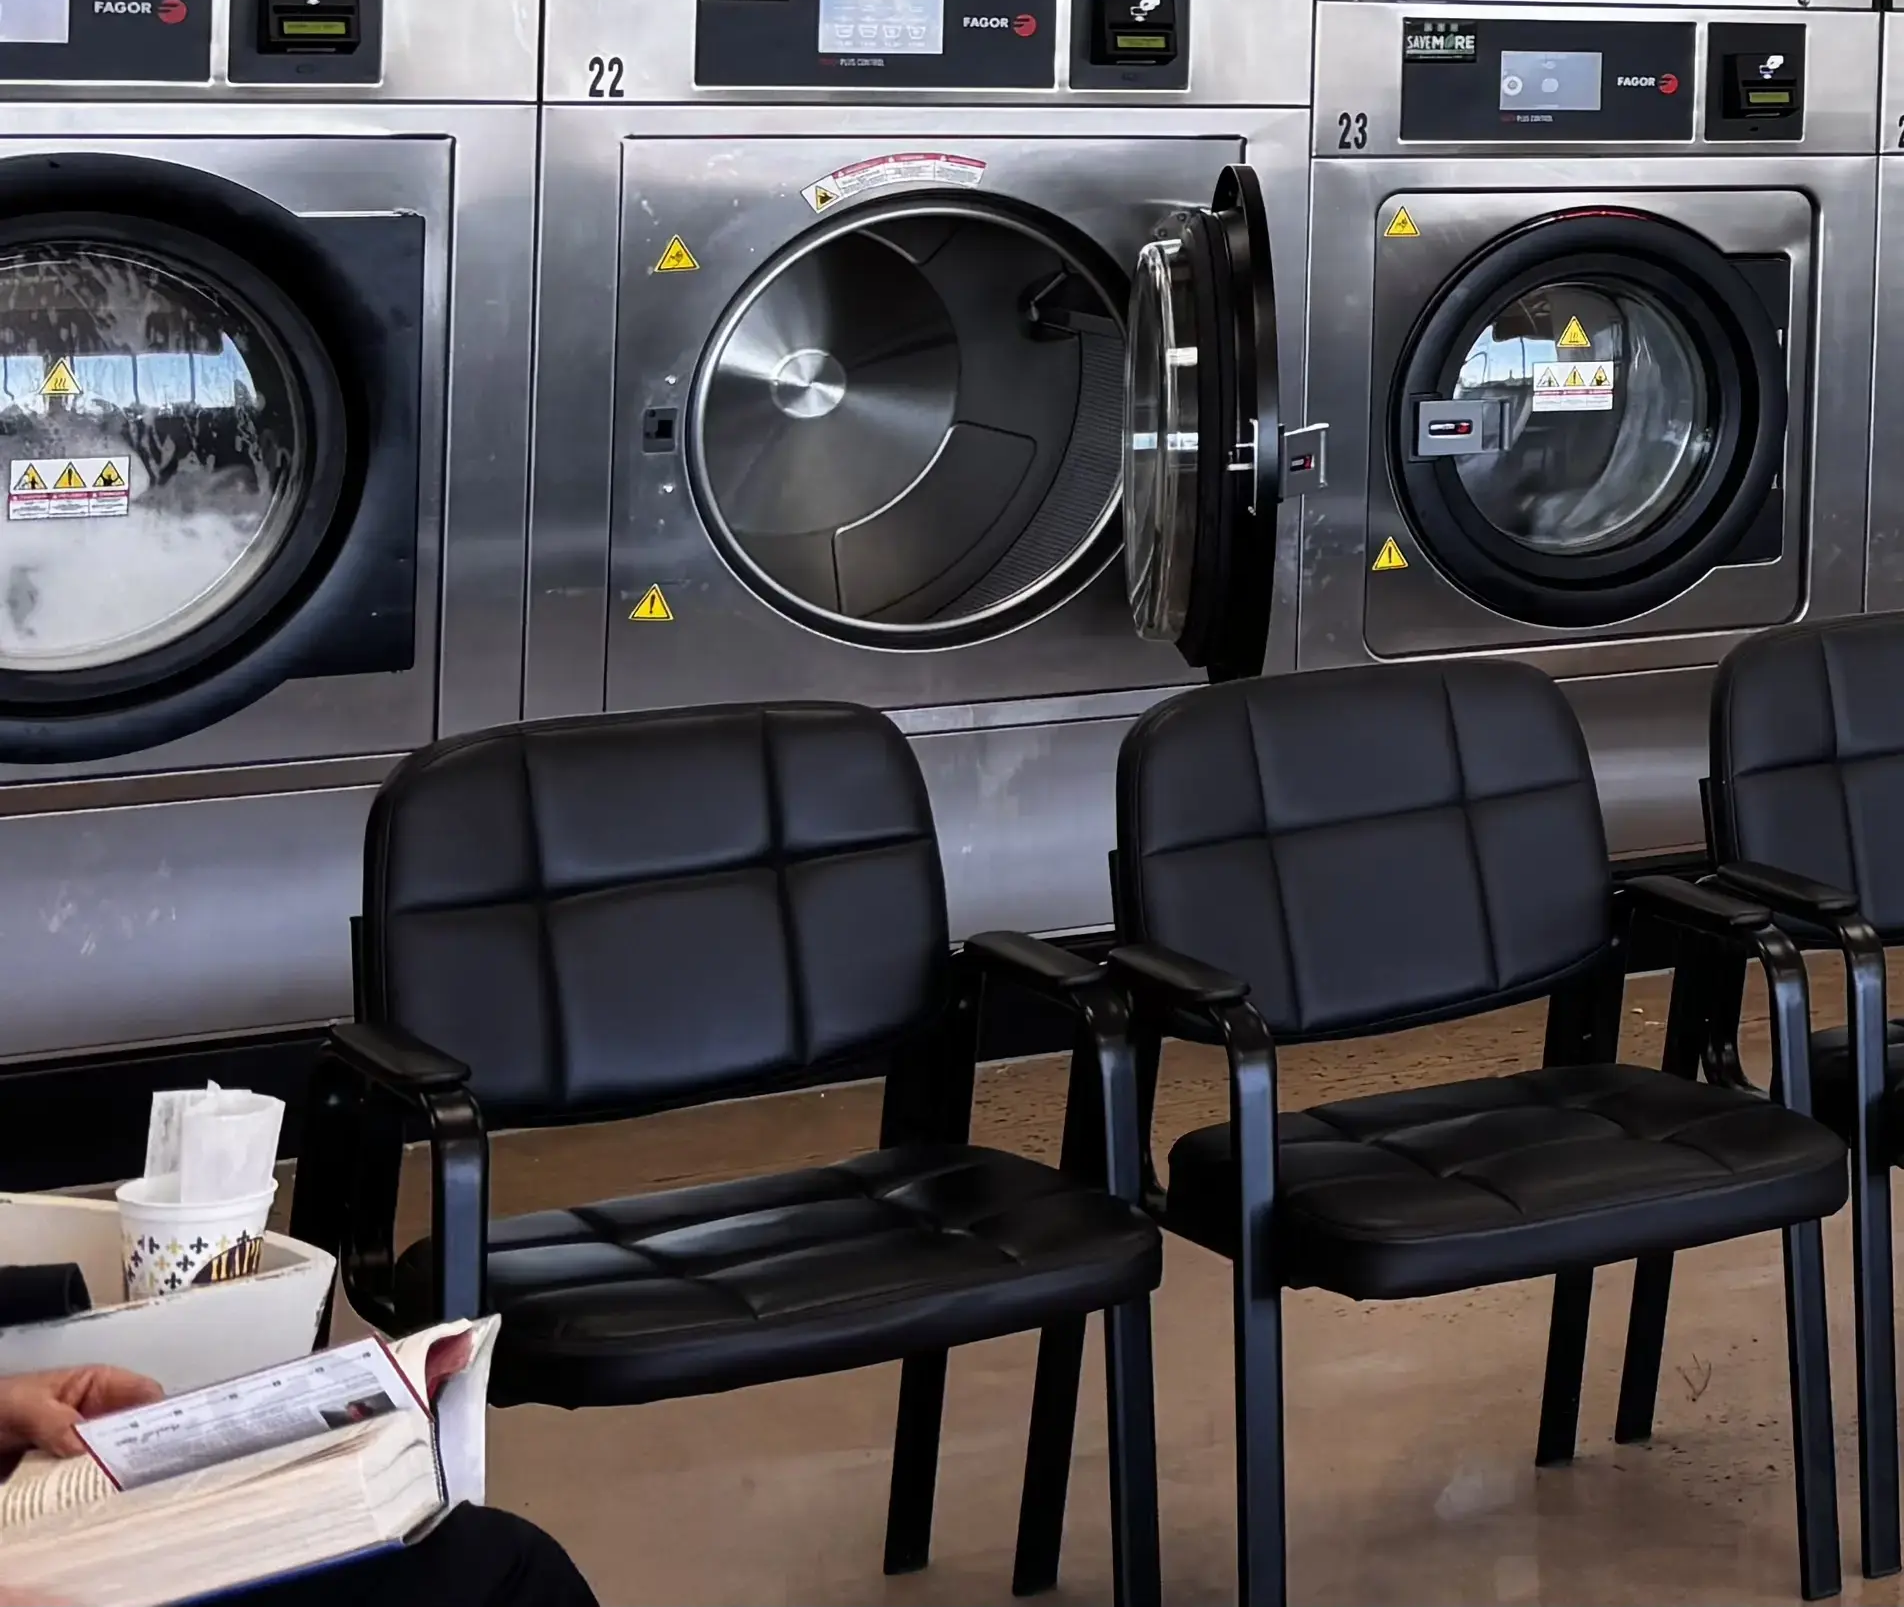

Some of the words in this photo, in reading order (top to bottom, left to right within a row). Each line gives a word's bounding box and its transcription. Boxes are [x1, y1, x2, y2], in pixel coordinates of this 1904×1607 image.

[94, 1, 152, 14] FAGOR
[962, 17, 1010, 29] FAGOR
[588, 56, 625, 98] 22
[1617, 76, 1656, 87] FAGOR
[1338, 112, 1368, 150] 23
